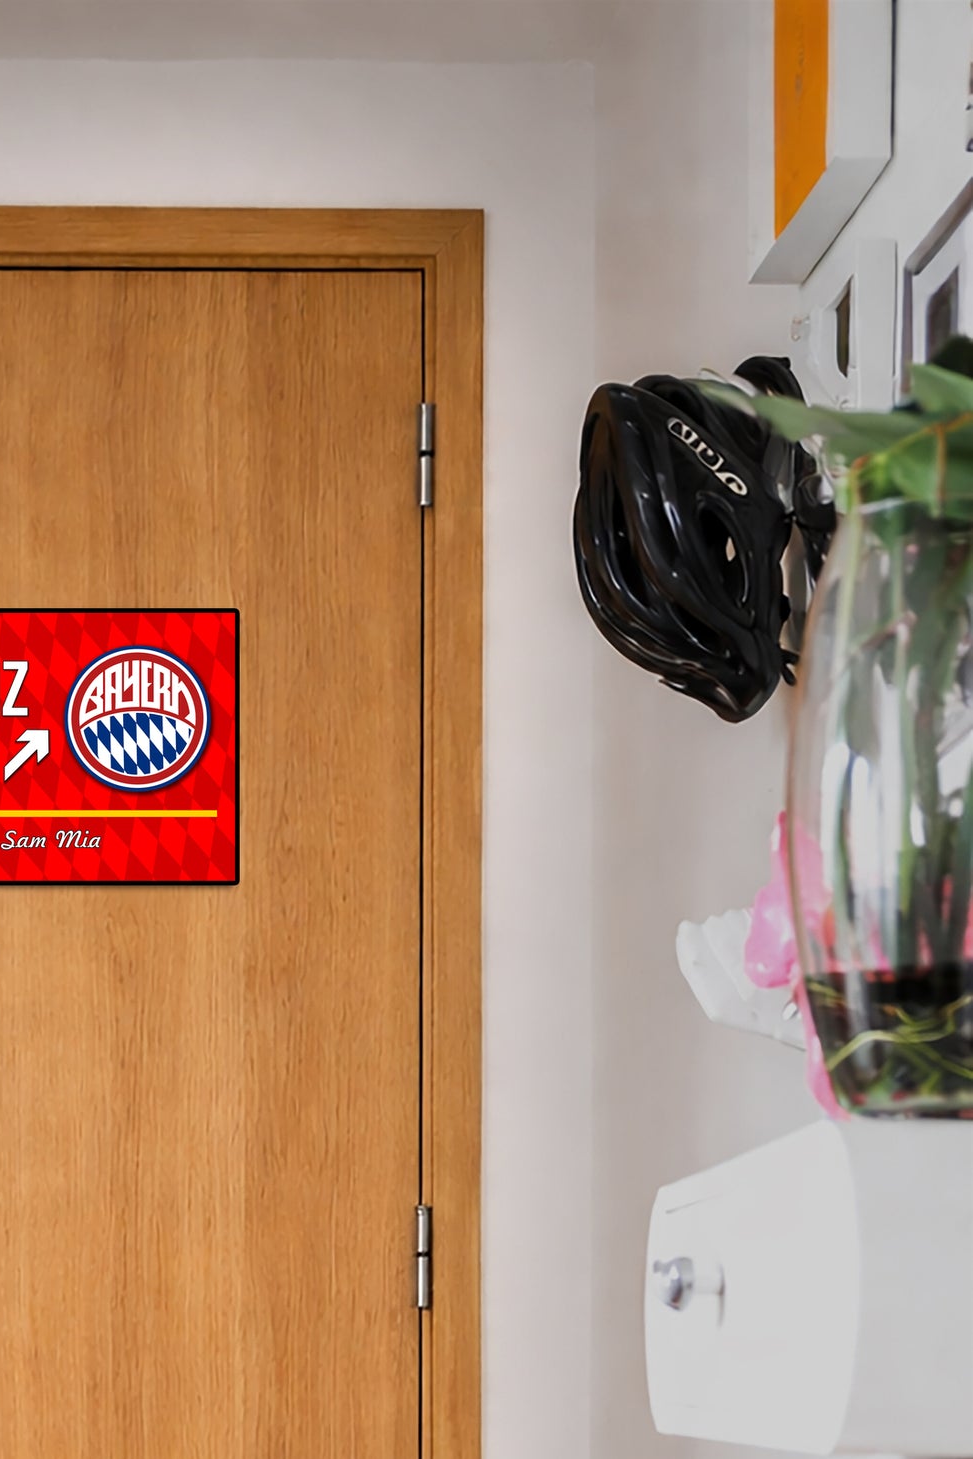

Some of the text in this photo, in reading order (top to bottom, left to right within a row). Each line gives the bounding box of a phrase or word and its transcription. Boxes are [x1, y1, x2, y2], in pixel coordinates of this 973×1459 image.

[78, 659, 197, 727] BAYERN
[0, 829, 47, 850] Sam
[55, 829, 101, 849] Mia
